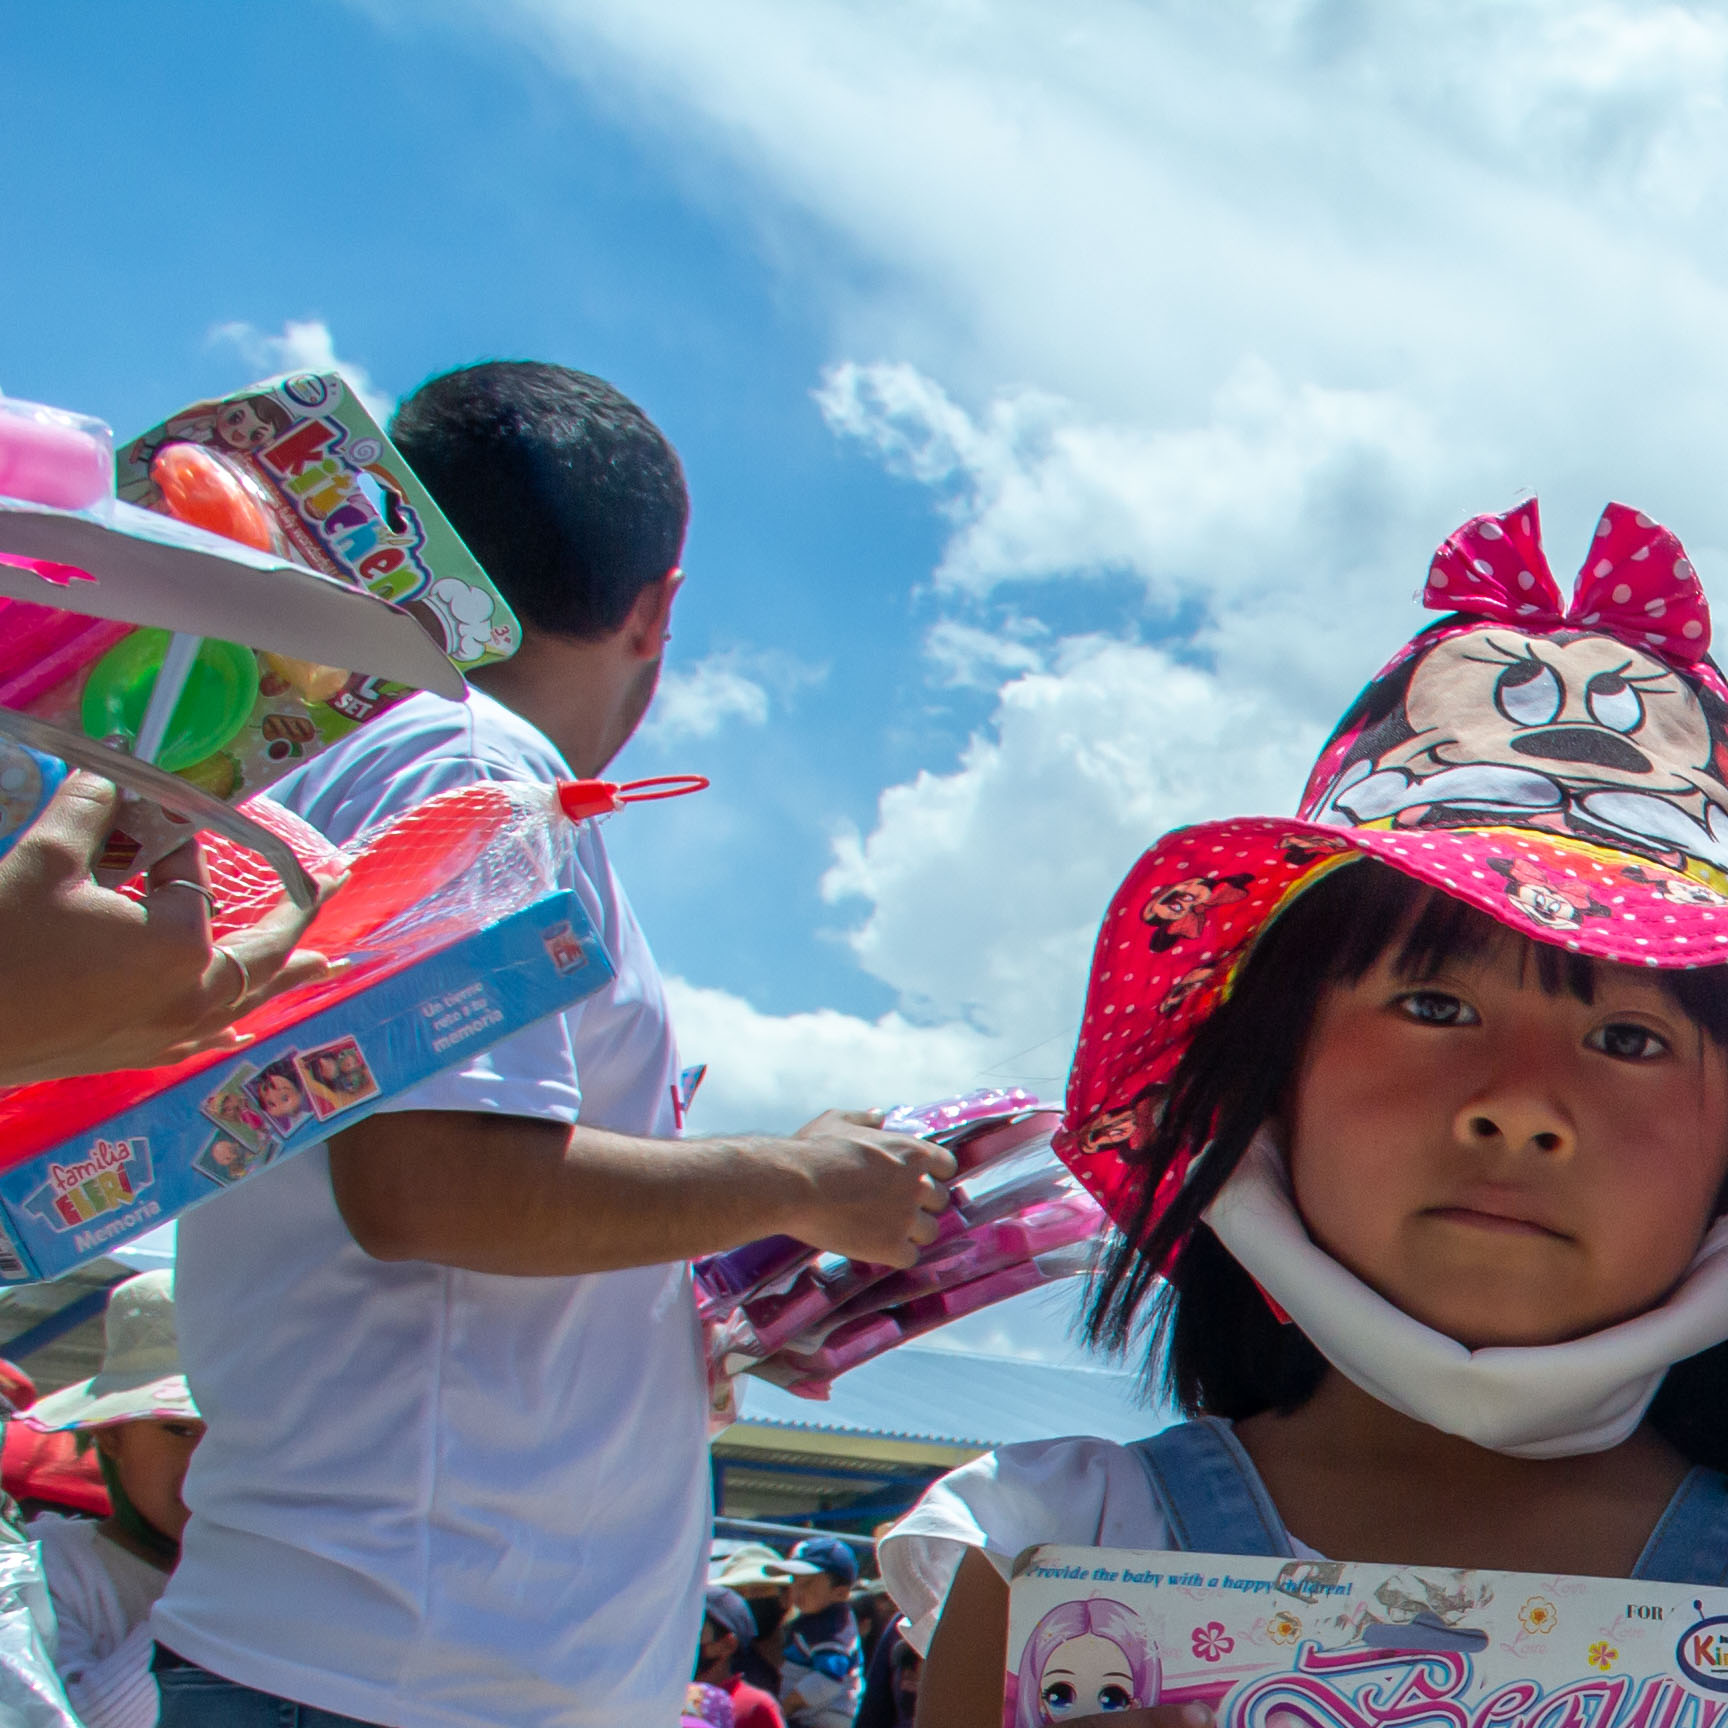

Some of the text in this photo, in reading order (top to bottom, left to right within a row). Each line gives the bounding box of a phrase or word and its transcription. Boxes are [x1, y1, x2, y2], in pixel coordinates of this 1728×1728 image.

[334, 693, 373, 719] SET
[432, 1010, 504, 1053] memoria
[52, 1141, 131, 1191] familia
[75, 1199, 161, 1252] Memoria
[1092, 1567, 1117, 1583] the
[1122, 1569, 1164, 1588] baby
[1167, 1572, 1203, 1587] with
[1207, 1576, 1219, 1588] a
[1223, 1574, 1274, 1594] happy
[1626, 1603, 1664, 1621] FOR
